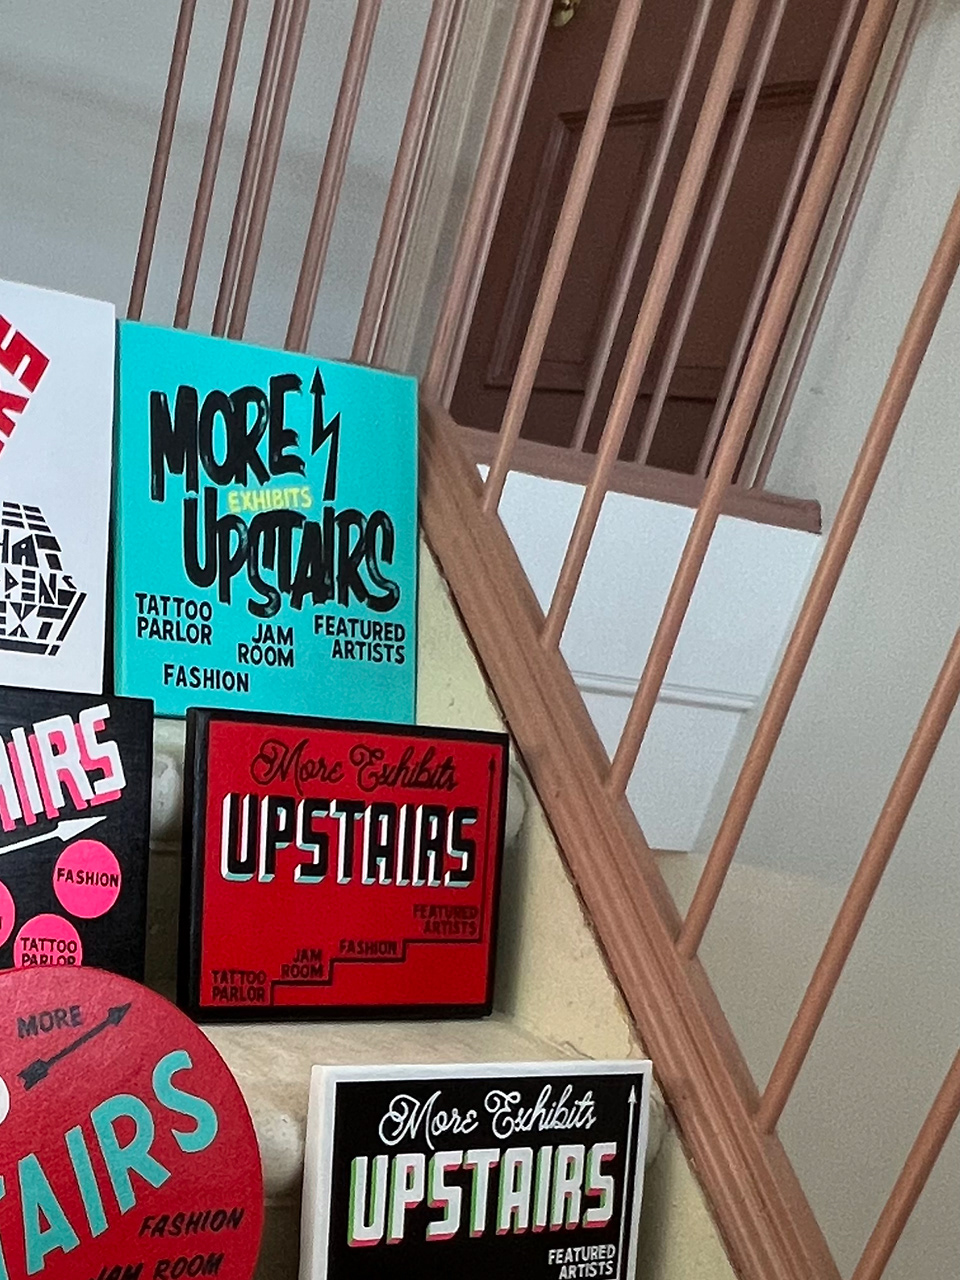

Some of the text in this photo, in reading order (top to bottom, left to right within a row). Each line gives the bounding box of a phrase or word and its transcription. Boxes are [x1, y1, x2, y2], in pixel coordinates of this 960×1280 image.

[150, 373, 306, 502] MORE
[227, 486, 312, 513] EXHIBITS
[183, 487, 400, 618] UPSTAIRS
[135, 592, 213, 622] TATTOO
[137, 617, 213, 645] PARLOR
[252, 623, 293, 646] JAM
[314, 614, 405, 641] FEATURED
[238, 643, 294, 668] ROOM
[332, 640, 405, 664] ARTISTS
[164, 664, 249, 692] FASHION
[250, 738, 458, 796] More Exhibits
[220, 792, 478, 888] UPSTAIRS
[57, 867, 119, 888] FASHION
[413, 904, 478, 920] FEATURED
[423, 920, 477, 935] ARTISTS
[21, 937, 78, 953] TATTOO
[293, 949, 322, 964] JAM
[340, 939, 398, 955] FASHION
[211, 969, 266, 985] TATTOO
[281, 963, 324, 979] ROOM
[212, 985, 265, 1002] PARLOR
[17, 1005, 82, 1039] MORE
[379, 1084, 596, 1149] More Exhibits
[347, 1142, 617, 1247] UPSTAIRS
[139, 1207, 245, 1238] FASHION
[548, 1244, 616, 1265] FEATURED
[559, 1261, 613, 1280] ARTISTS
